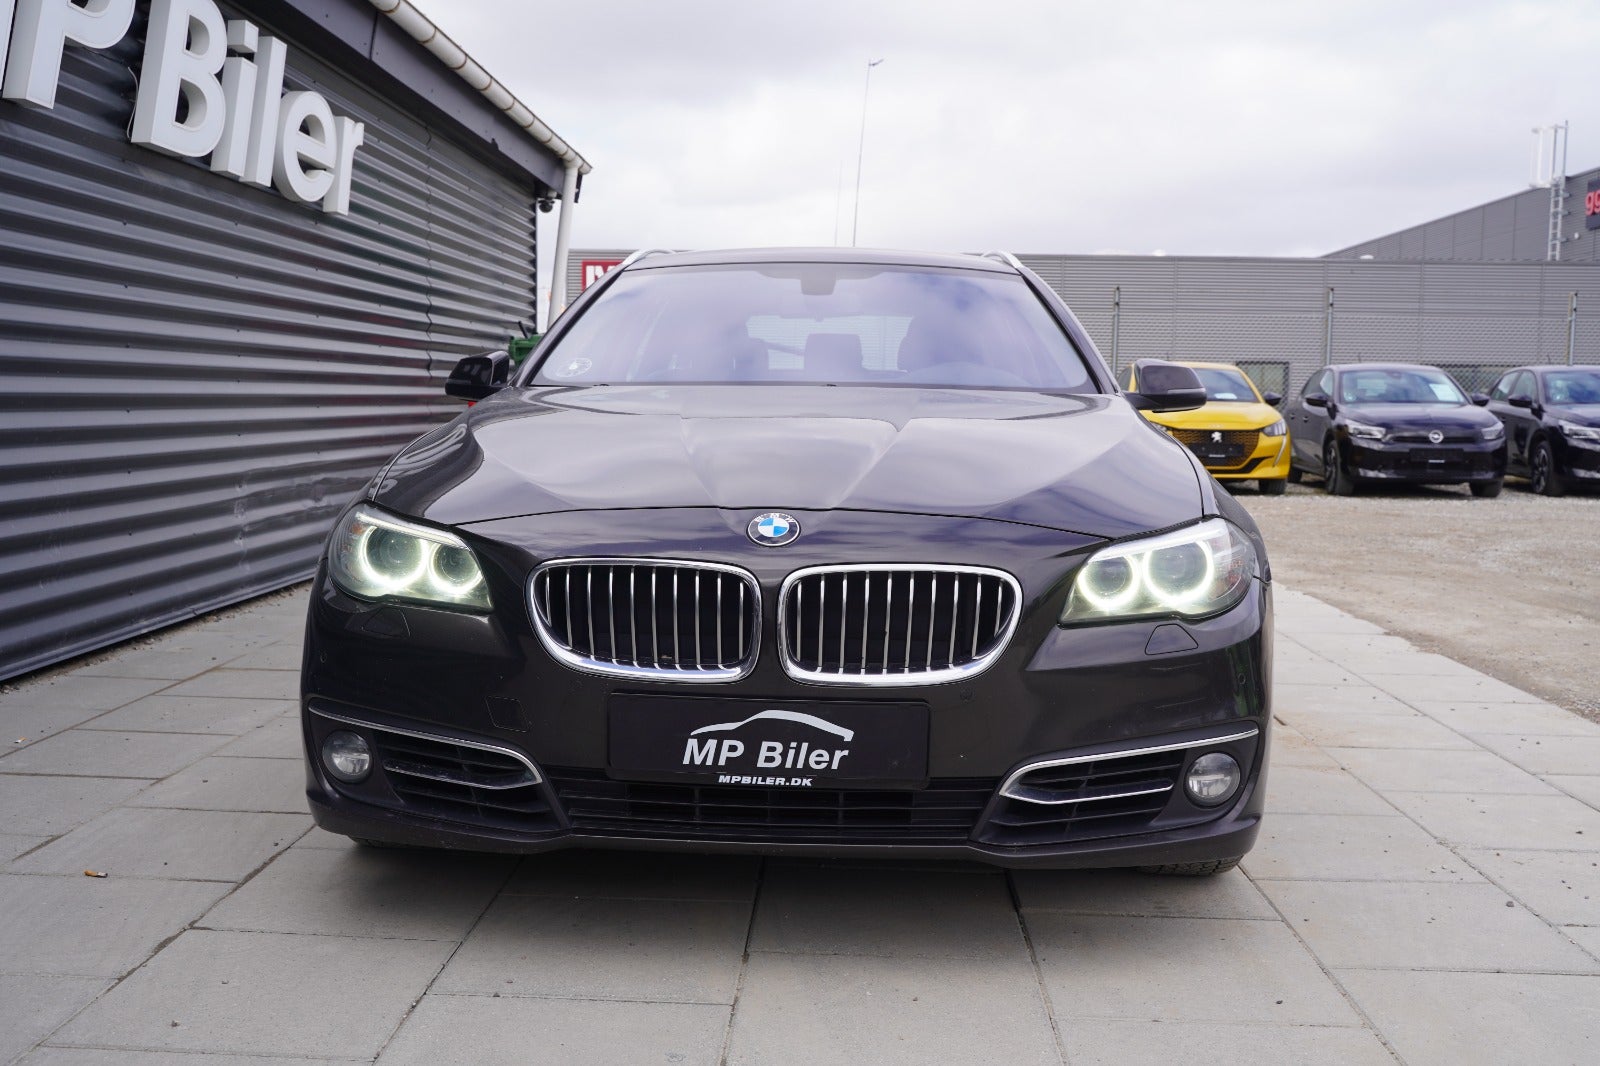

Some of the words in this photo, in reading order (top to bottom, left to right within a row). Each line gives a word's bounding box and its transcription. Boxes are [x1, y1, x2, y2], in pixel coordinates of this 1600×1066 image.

[0, 0, 135, 110] P
[131, 0, 365, 216] Biler
[682, 738, 745, 766] MP
[756, 740, 849, 770] Biler
[718, 774, 813, 787] MPBILER.DK
